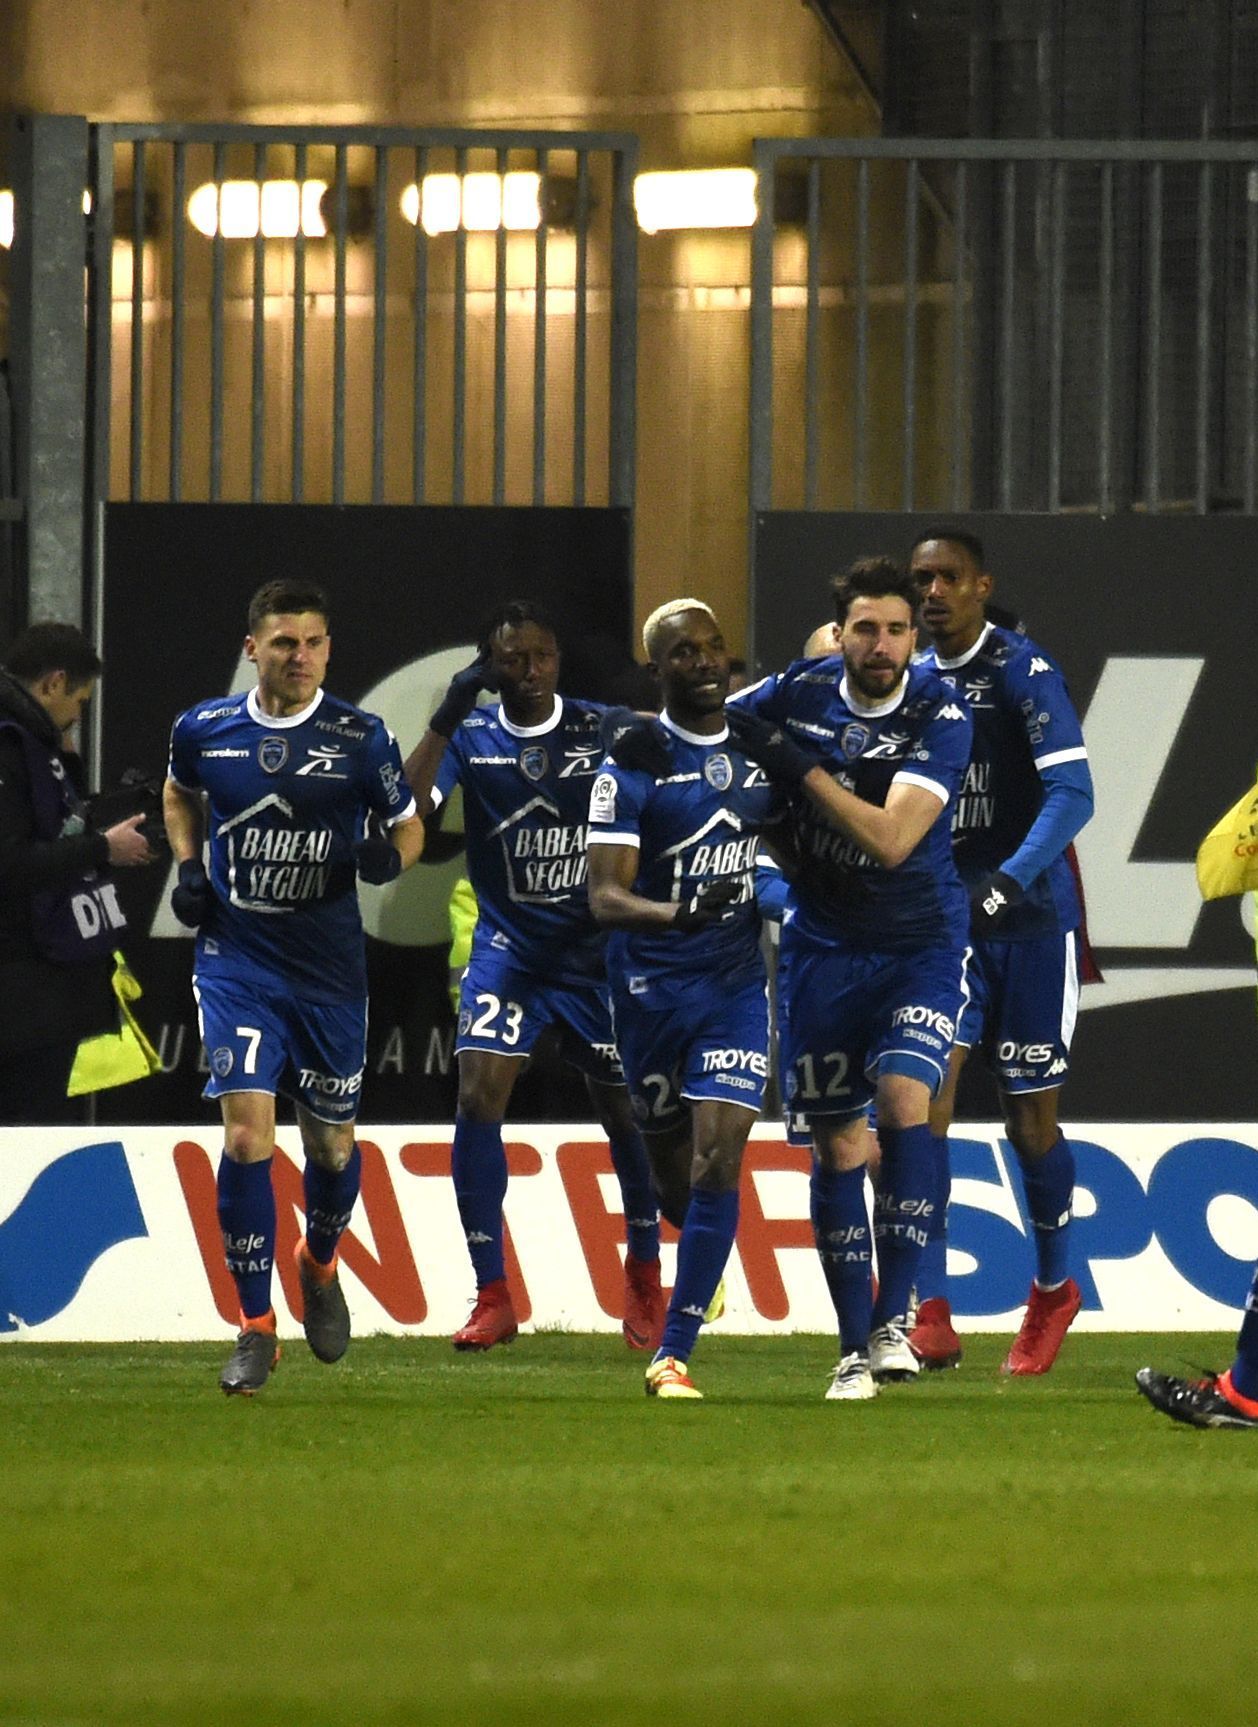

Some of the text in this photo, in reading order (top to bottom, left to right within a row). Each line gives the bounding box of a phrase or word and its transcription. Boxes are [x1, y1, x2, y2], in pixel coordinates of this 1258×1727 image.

[241, 827, 333, 863] BABEAU
[249, 865, 332, 900] SEGUIN
[471, 993, 524, 1046] 23
[892, 1005, 955, 1043] TROYES
[236, 1027, 261, 1074] 7
[702, 1048, 768, 1078] TROYES
[796, 1051, 851, 1099] 12
